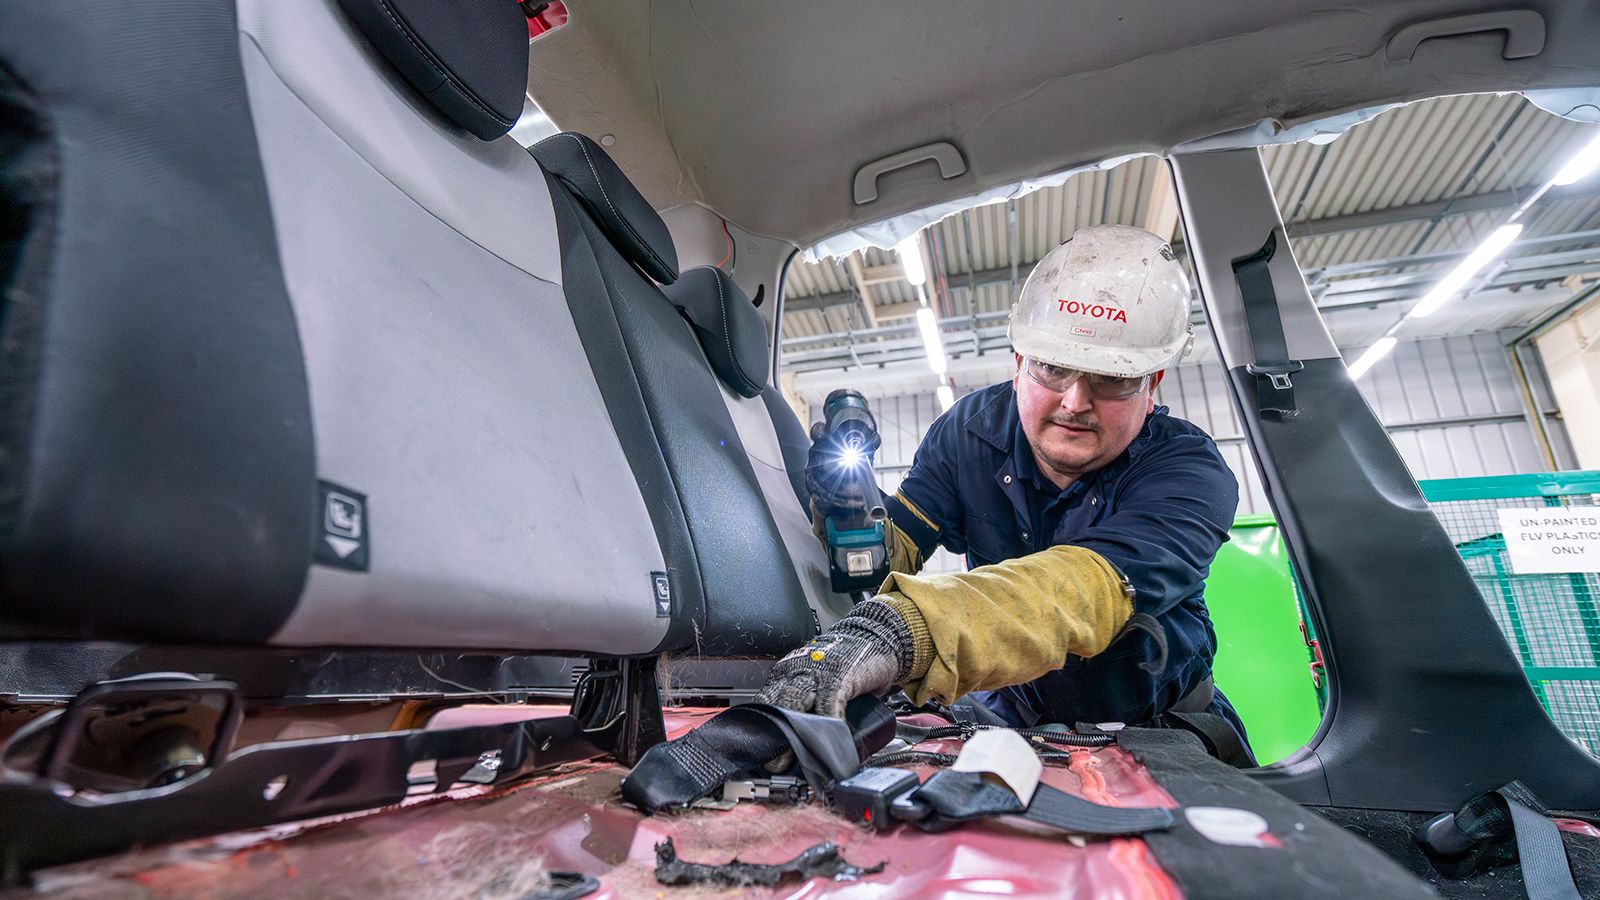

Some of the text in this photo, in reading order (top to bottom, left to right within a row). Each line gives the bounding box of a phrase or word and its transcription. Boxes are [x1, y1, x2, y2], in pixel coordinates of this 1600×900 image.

[1058, 299, 1127, 323] TOYOTA
[1520, 518, 1597, 527] UN-PAINTED
[1551, 546, 1585, 555] ONLY
